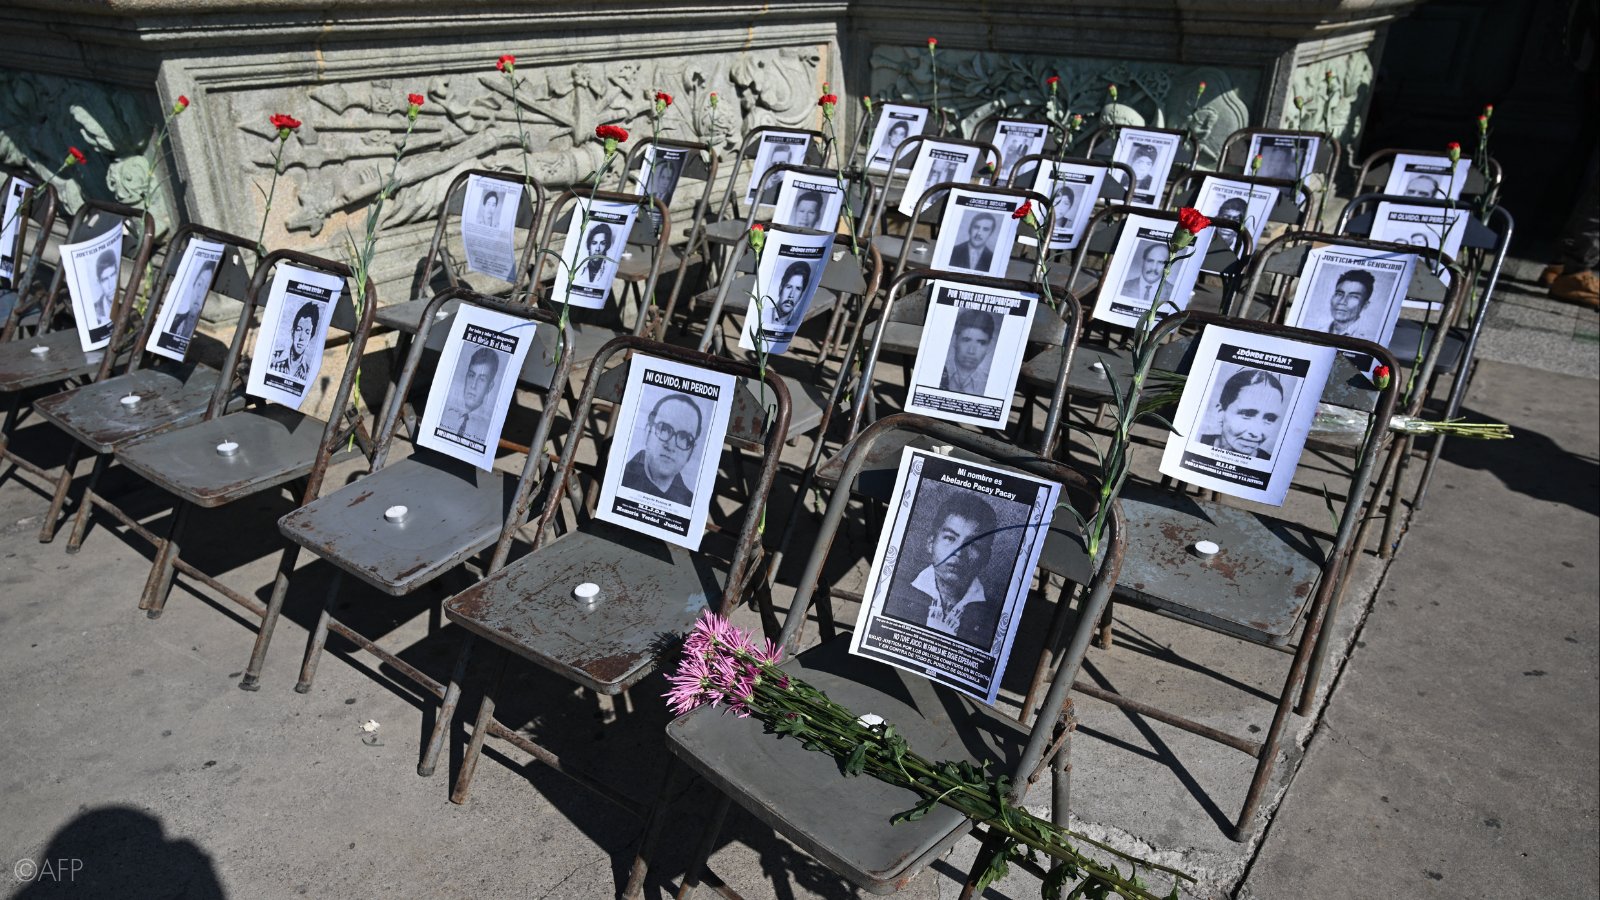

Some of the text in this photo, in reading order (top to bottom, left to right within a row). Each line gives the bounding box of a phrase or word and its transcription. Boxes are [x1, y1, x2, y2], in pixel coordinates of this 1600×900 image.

[1322, 254, 1352, 264] JUSTICIA
[1367, 261, 1402, 271] GENOCIDIO
[947, 289, 1021, 308] POR TODOS LOS DESAPARECIDOS
[646, 371, 718, 397] NI OLVIDO, NI PERDON
[957, 467, 1003, 486] Mi nombre es
[940, 474, 1017, 500] Abelardo Pacay Pacay
[616, 505, 639, 517] Memoria
[642, 514, 660, 524] Verdad
[882, 638, 902, 648] JUSTICIA
[922, 651, 940, 660] DELITOS
[940, 658, 964, 670] COMETIDOS
[900, 634, 910, 644] TUVE
[928, 644, 941, 654] FAMILIA
[889, 646, 907, 655] CONTRA
[915, 654, 927, 662] TODO
[933, 660, 950, 670] PUEBLO
[956, 670, 980, 683] GUATEMALA
